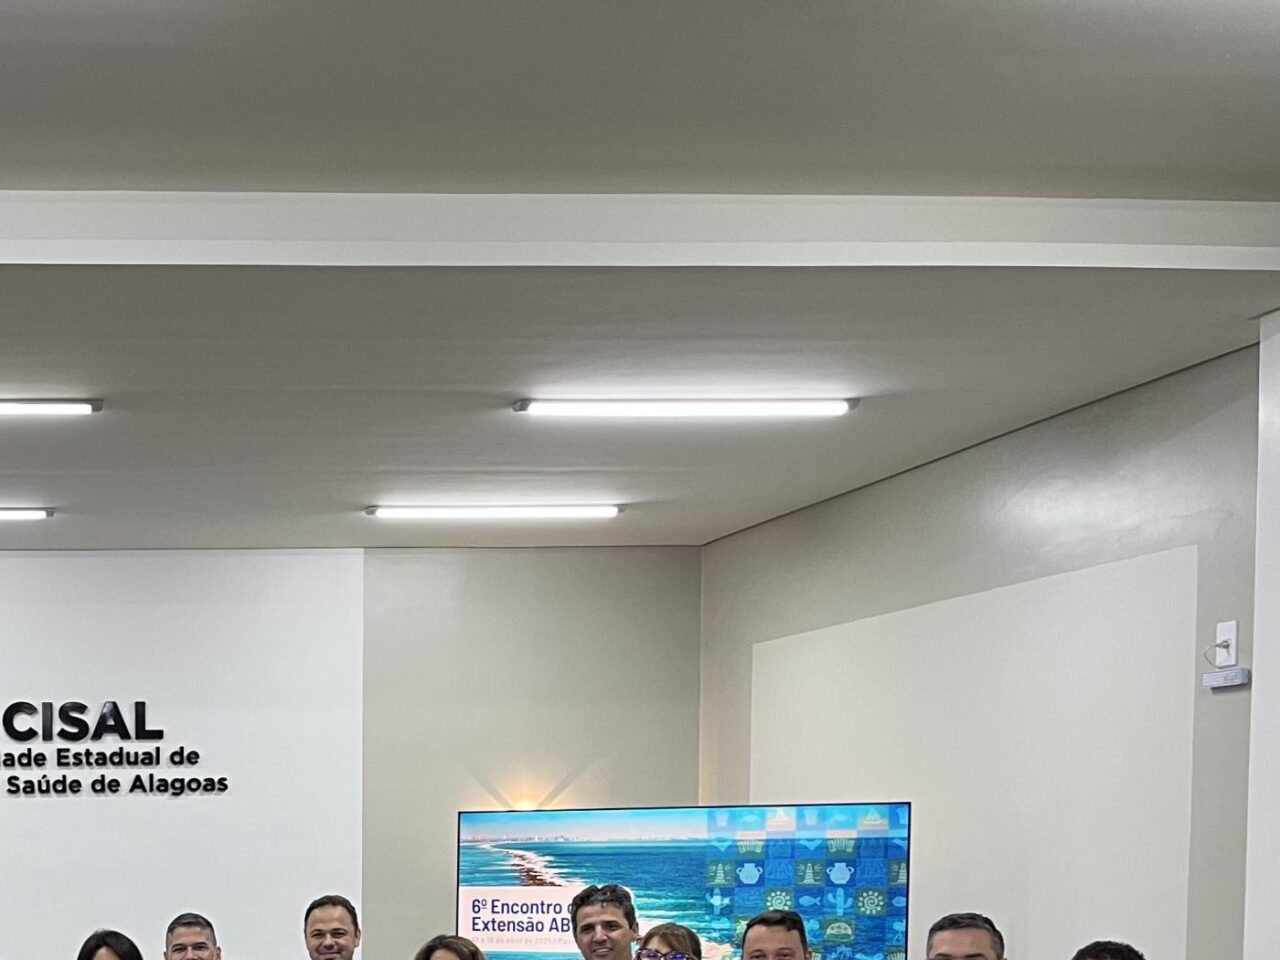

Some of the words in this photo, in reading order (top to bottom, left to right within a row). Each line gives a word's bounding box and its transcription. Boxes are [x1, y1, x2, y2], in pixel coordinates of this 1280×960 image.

[56, 746, 161, 767] Estadual
[170, 746, 200, 766] de
[7, 774, 82, 795] Saúde
[91, 774, 121, 794] de
[129, 773, 228, 797] Alagoas
[471, 898, 488, 915] 6º
[491, 898, 563, 915] Encontro
[471, 916, 545, 932] Extensão
[548, 917, 571, 933] AB
